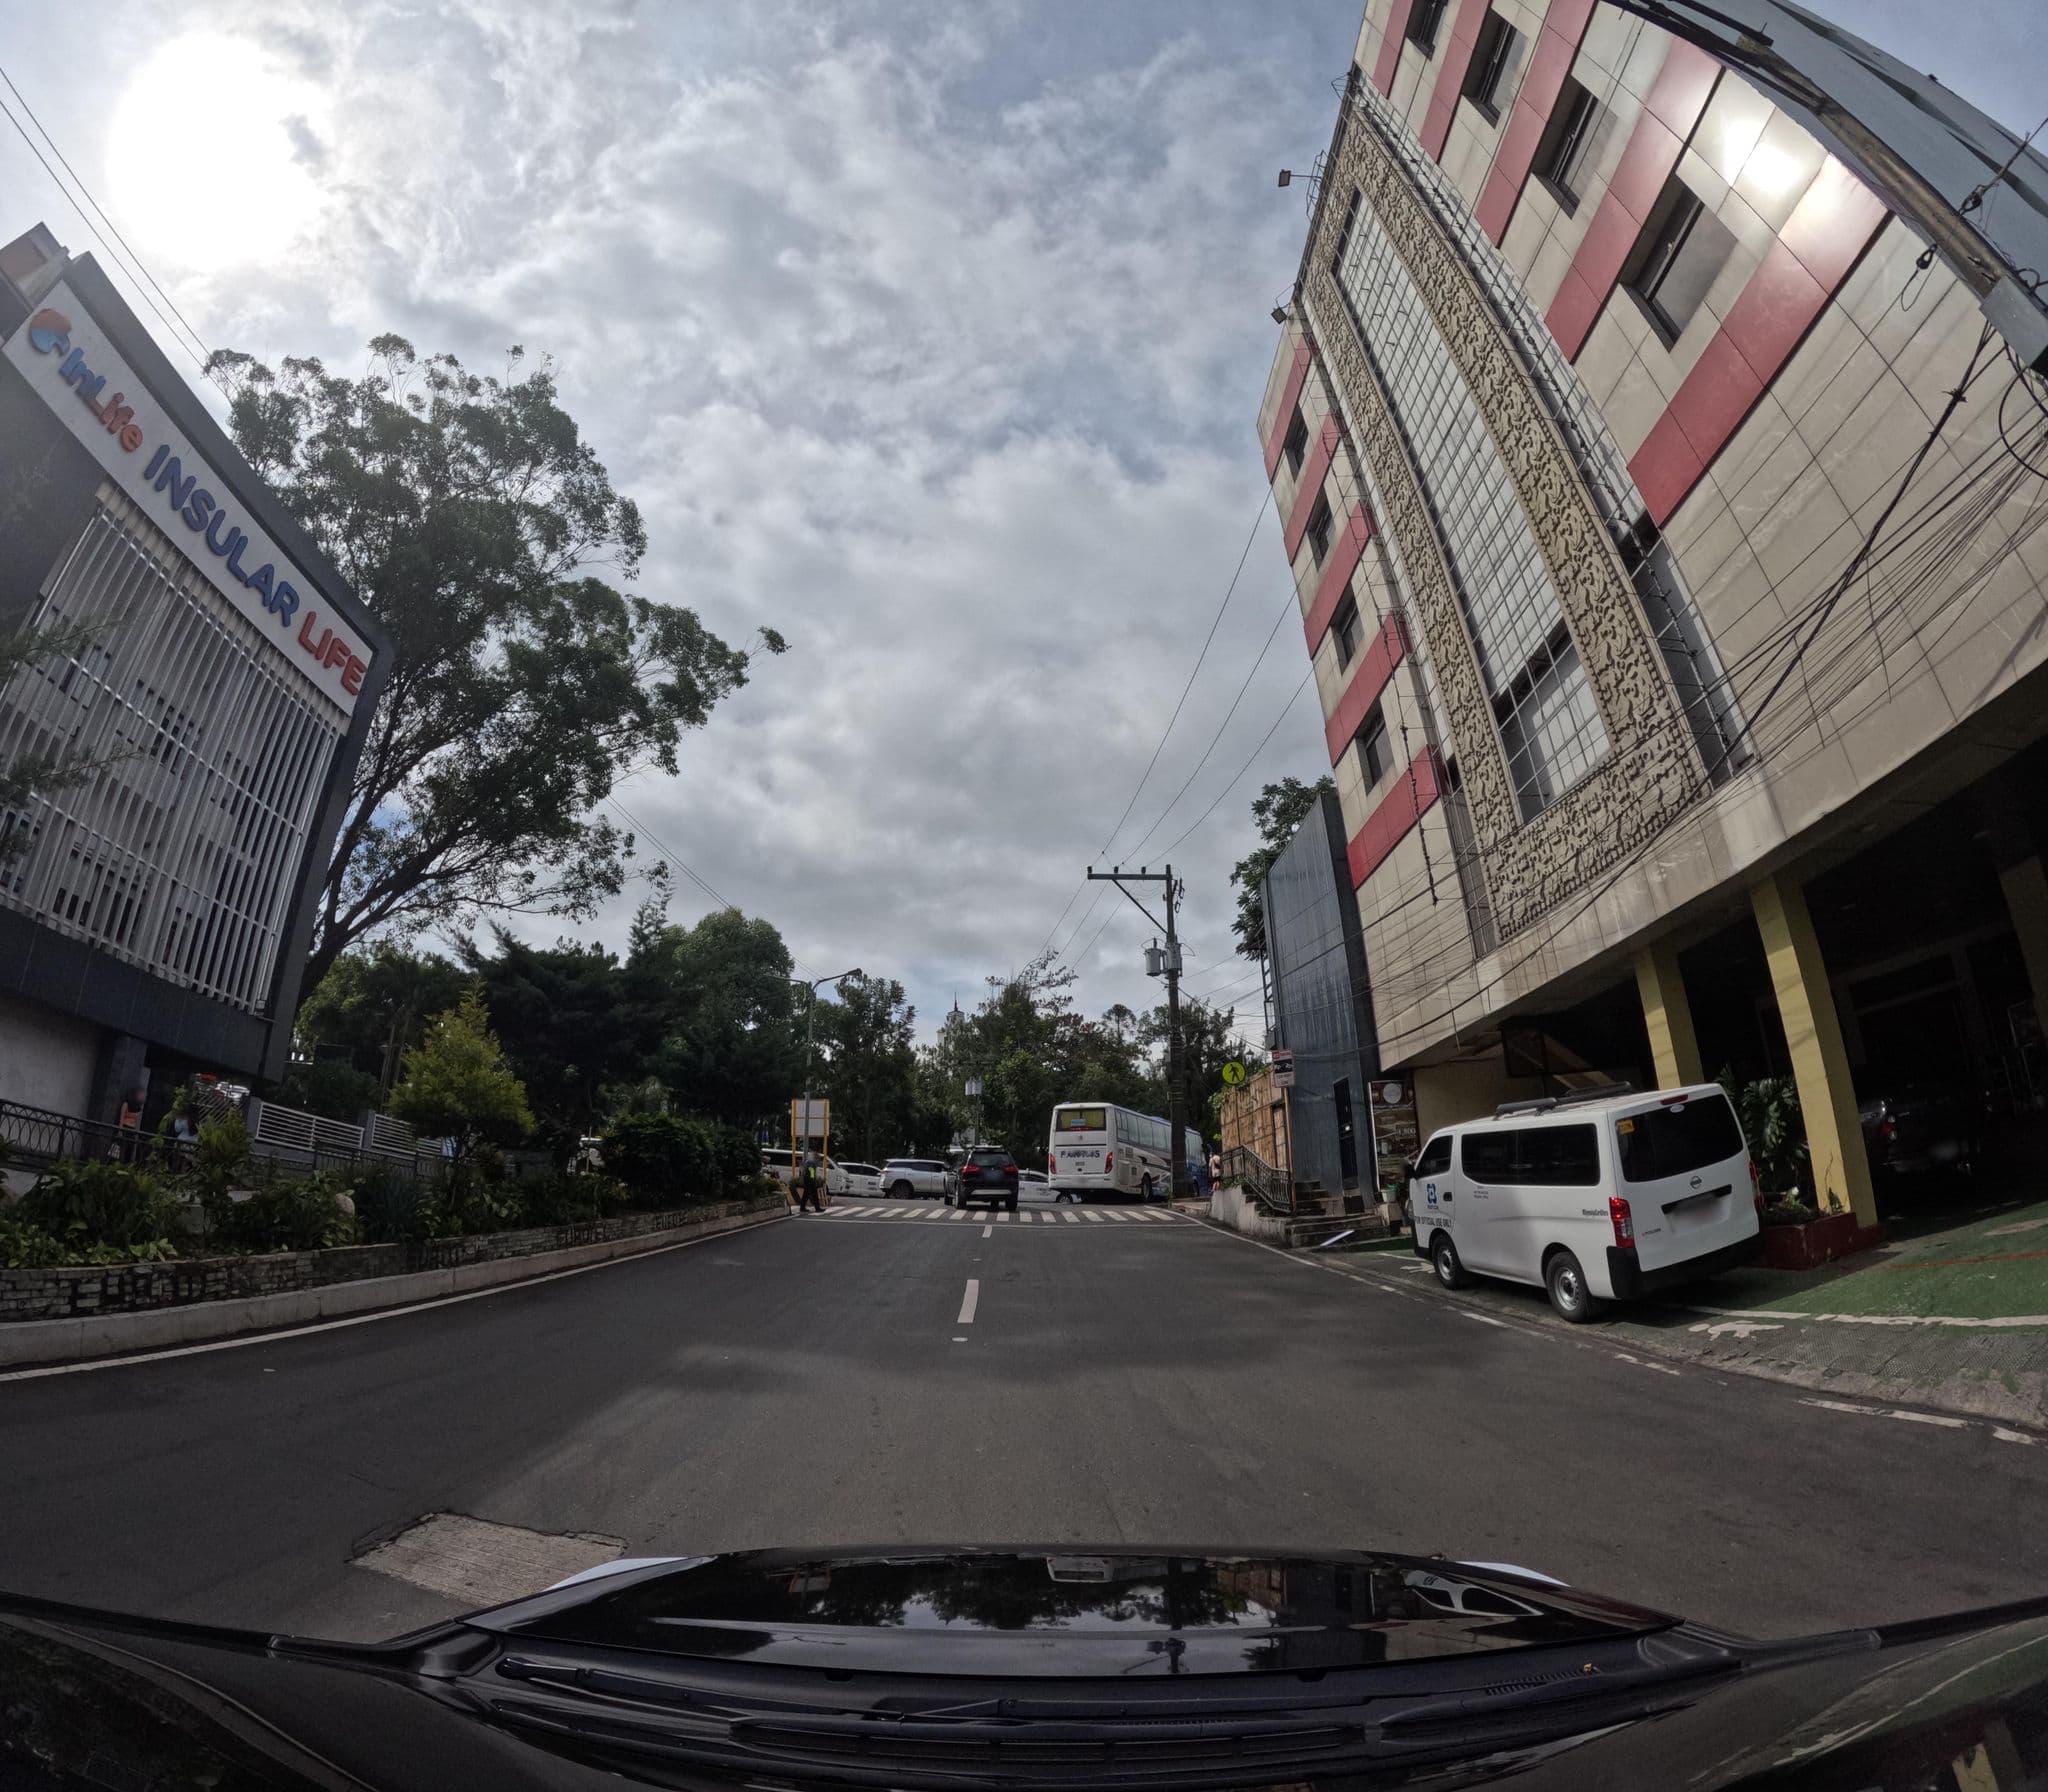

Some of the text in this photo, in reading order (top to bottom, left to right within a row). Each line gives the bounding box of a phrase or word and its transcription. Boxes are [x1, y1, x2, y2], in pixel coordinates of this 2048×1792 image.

[59, 347, 368, 696] InLife INSULAR LIFE
